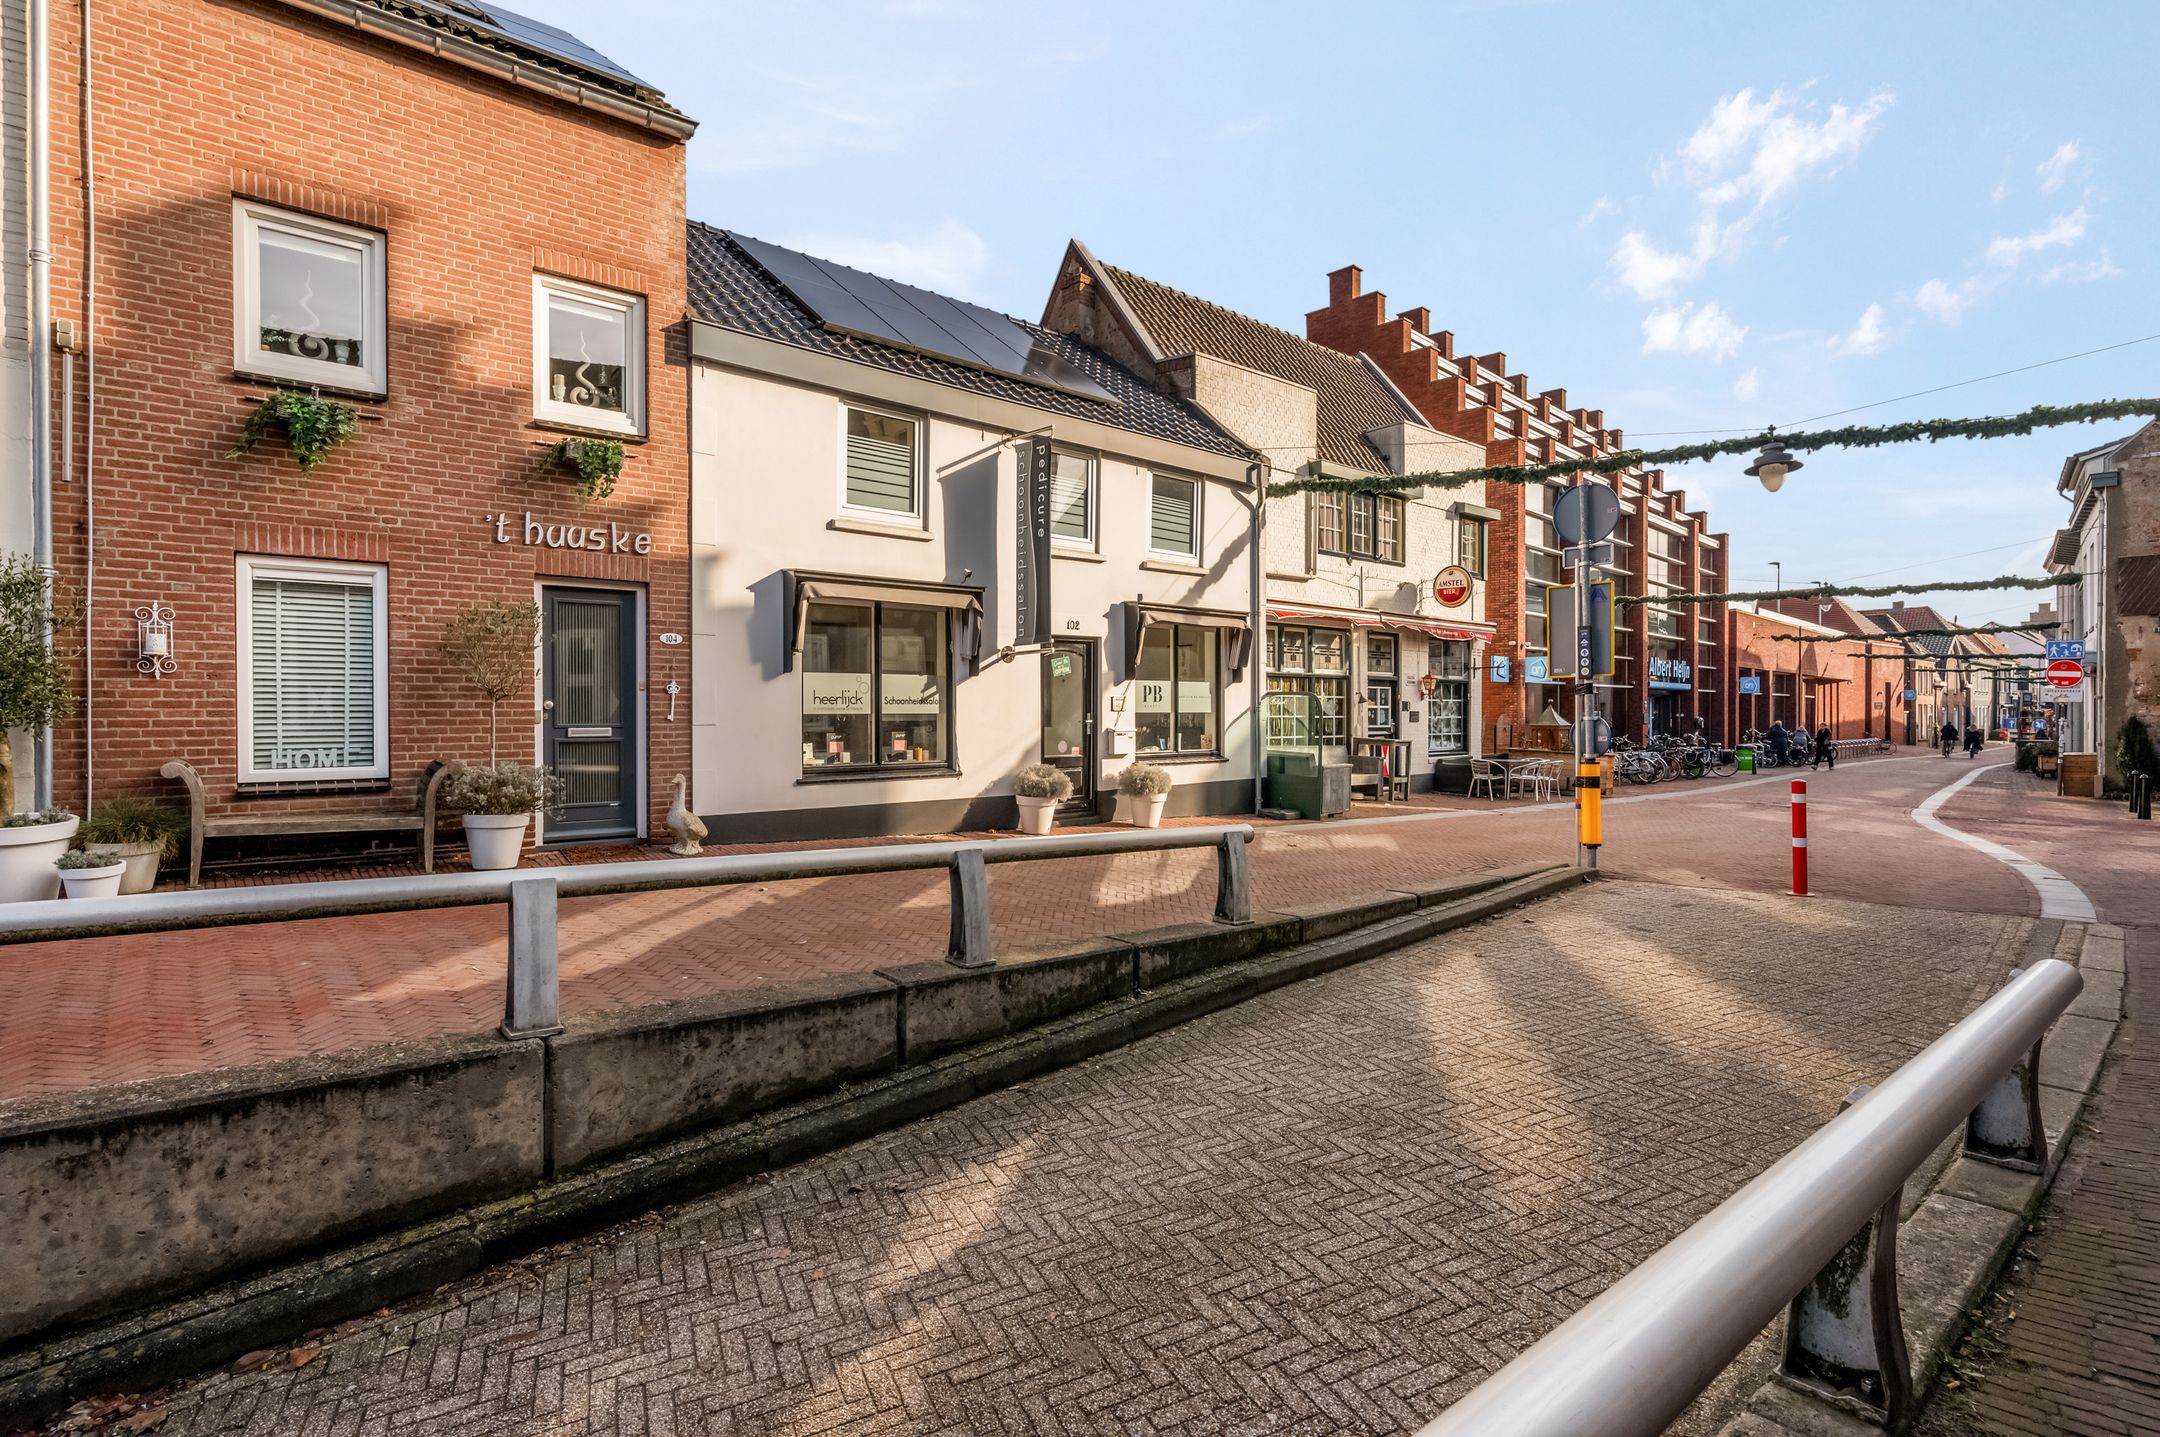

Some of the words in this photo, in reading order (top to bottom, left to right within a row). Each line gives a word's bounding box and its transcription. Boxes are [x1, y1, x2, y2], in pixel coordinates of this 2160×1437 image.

[1036, 445, 1048, 538] pedicure
[1017, 450, 1028, 638] schoonheidssalon
[1439, 579, 1464, 587] AMSTEL
[1066, 620, 1081, 631] 102
[665, 634, 678, 643] 104
[1649, 656, 1672, 677] Albert
[1673, 659, 1691, 683] Heijn
[813, 689, 864, 708] heerlijck
[1143, 685, 1163, 702] PB
